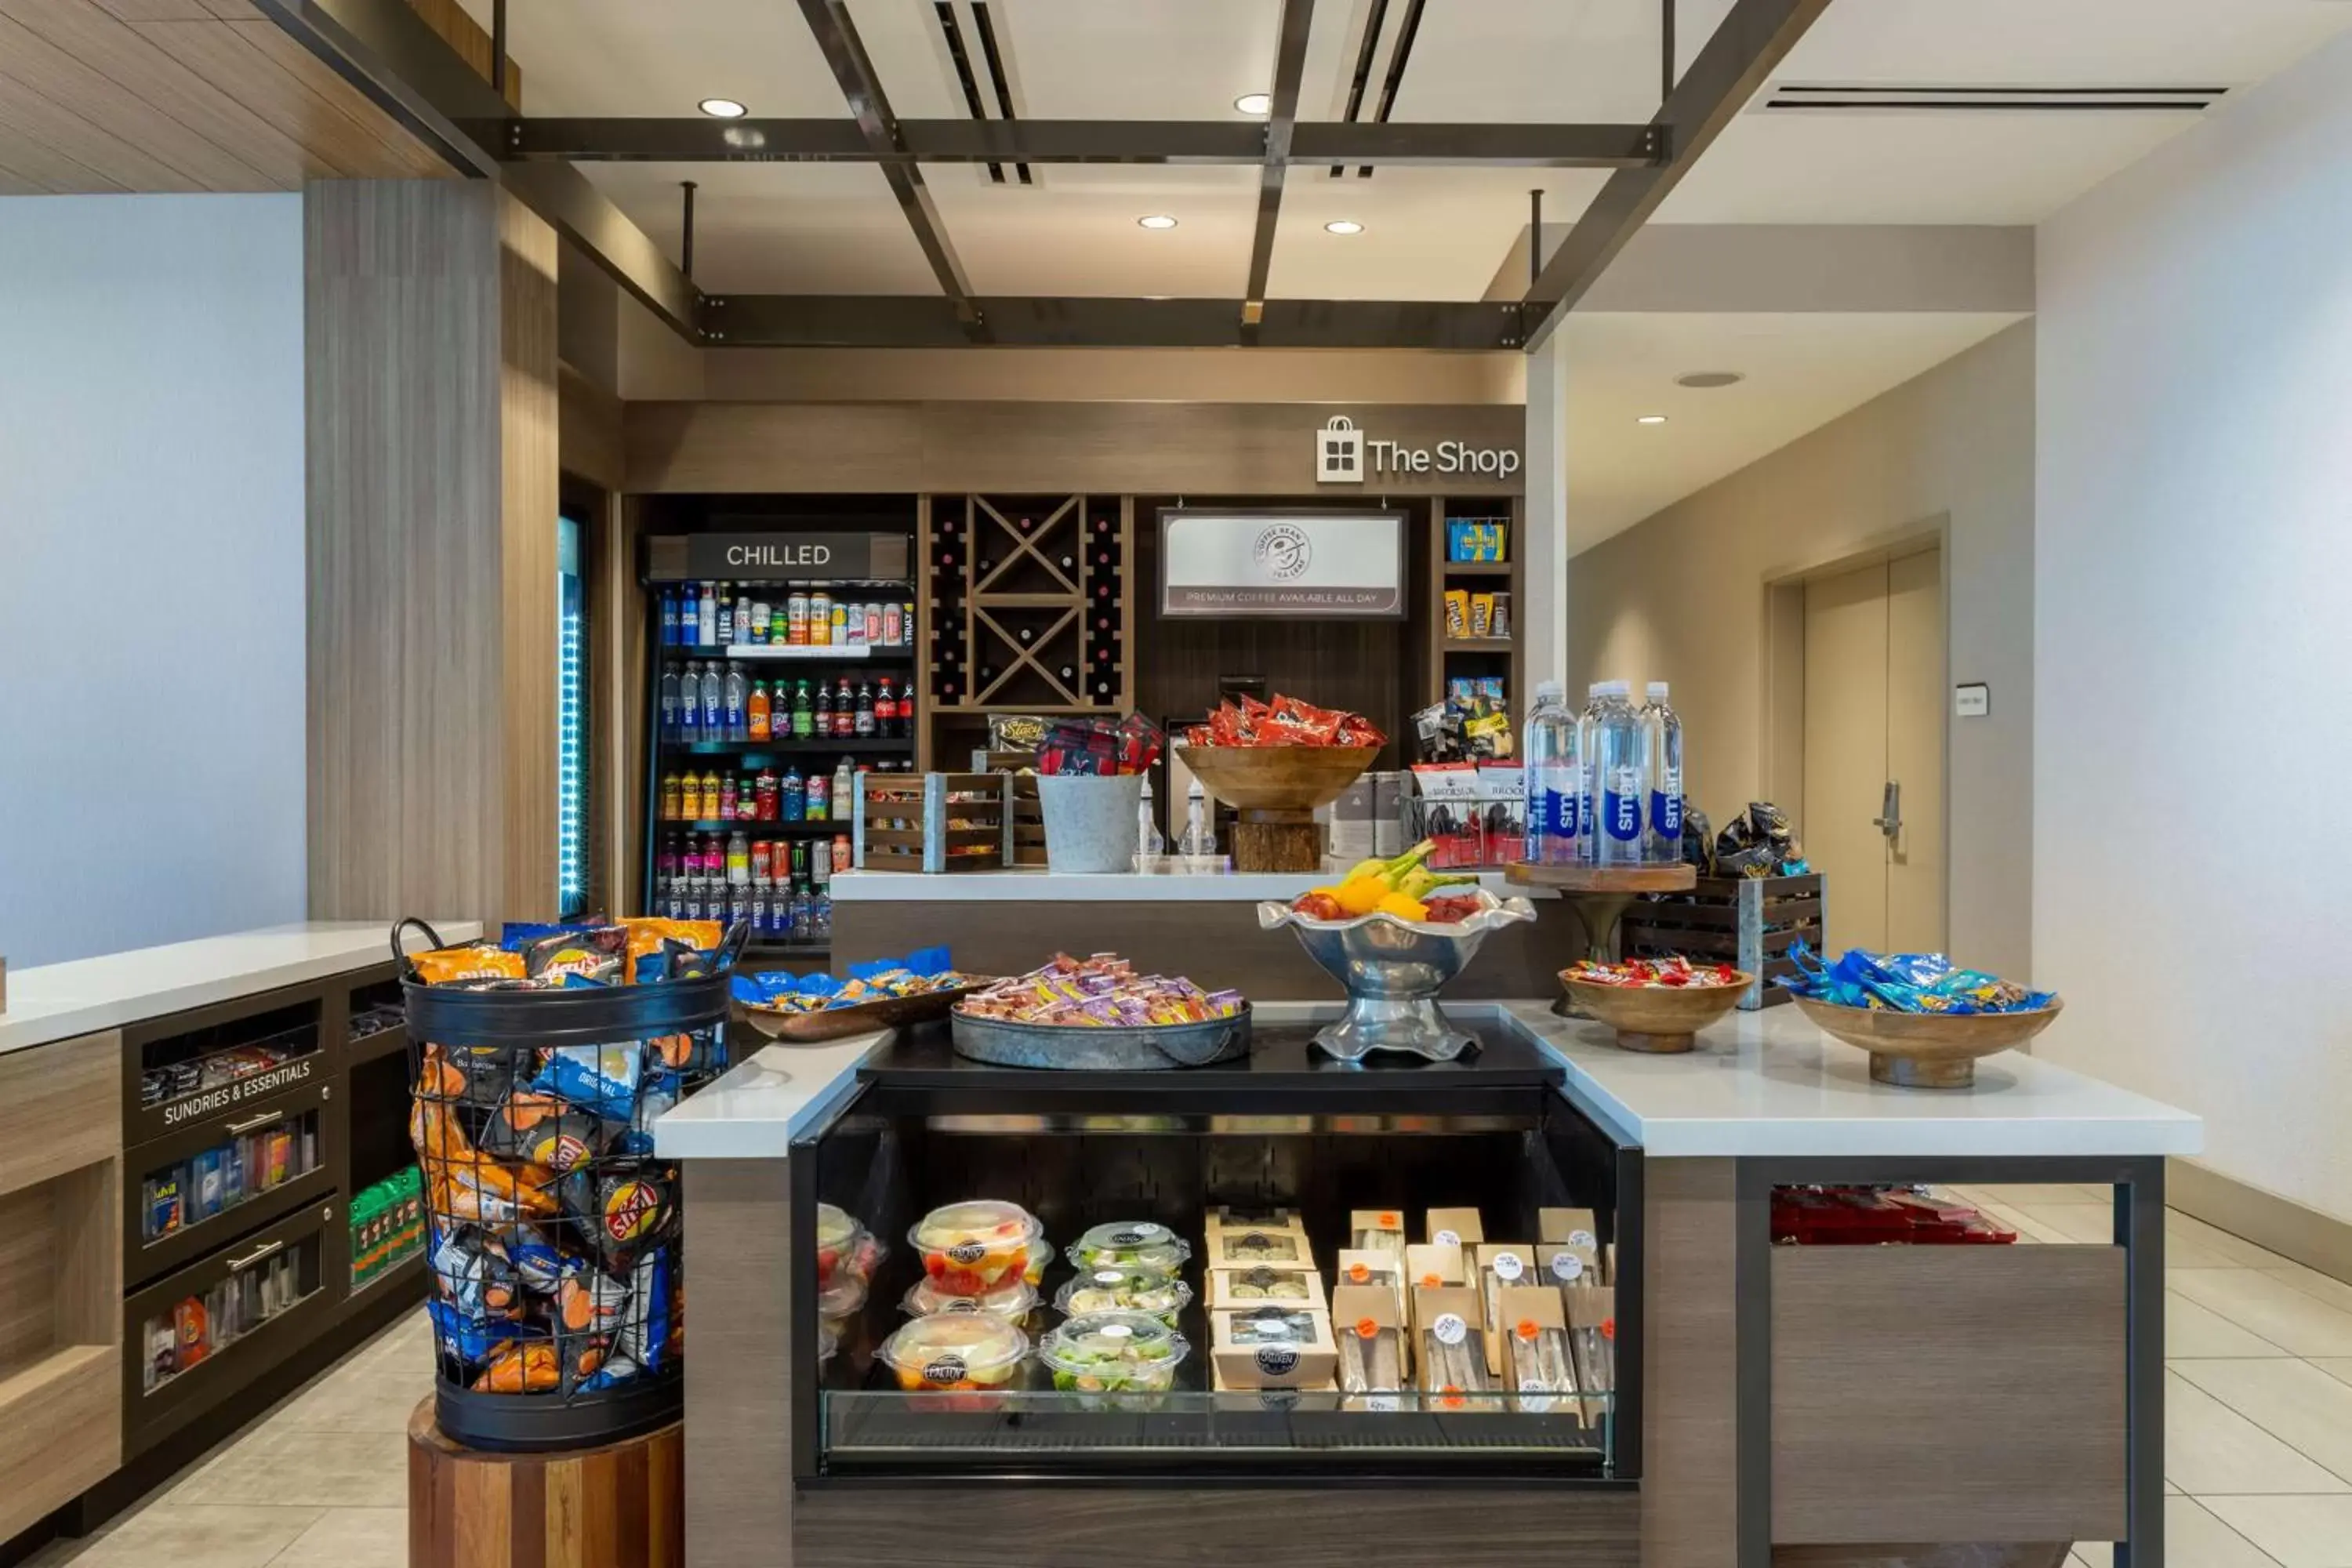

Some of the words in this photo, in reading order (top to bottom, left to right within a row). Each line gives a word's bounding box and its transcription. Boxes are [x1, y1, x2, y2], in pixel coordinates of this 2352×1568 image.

[1367, 440, 1430, 473] The
[1436, 441, 1520, 479] Shop
[727, 546, 831, 566] CHILLED
[1185, 593, 1236, 603] PREMIUM
[1236, 593, 1276, 603] COFFEE
[1279, 593, 1333, 604] AVAILABLE
[1335, 594, 1355, 604] ALL
[1357, 594, 1378, 604] DAY
[904, 613, 913, 642] TRULY
[1617, 763, 1633, 832] smart
[1664, 765, 1679, 829] smart
[164, 1088, 230, 1126] SUNDRIES
[232, 1084, 241, 1102] &
[244, 1060, 311, 1098] ESSENTIALS
